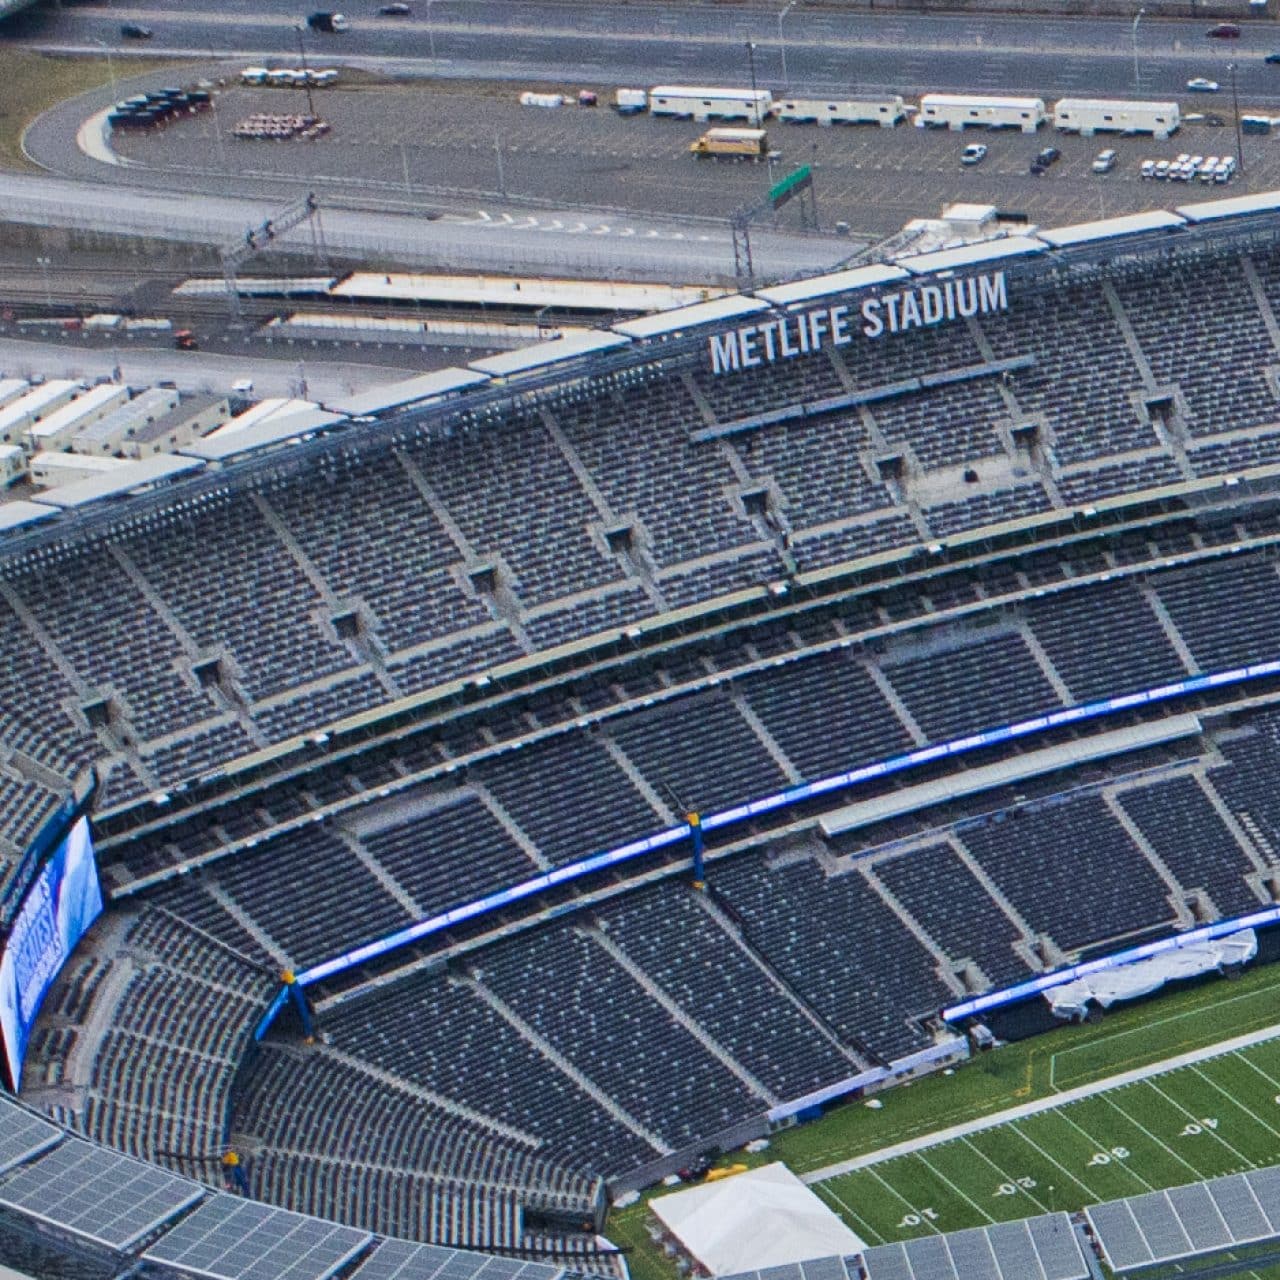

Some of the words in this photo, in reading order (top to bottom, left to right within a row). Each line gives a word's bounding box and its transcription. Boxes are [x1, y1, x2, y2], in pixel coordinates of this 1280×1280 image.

[709, 305, 852, 374] METLIFE
[862, 272, 1008, 338] STADIUM
[1185, 1118, 1219, 1135] 40
[999, 1176, 1037, 1195] 20
[901, 1207, 940, 1227] 10
